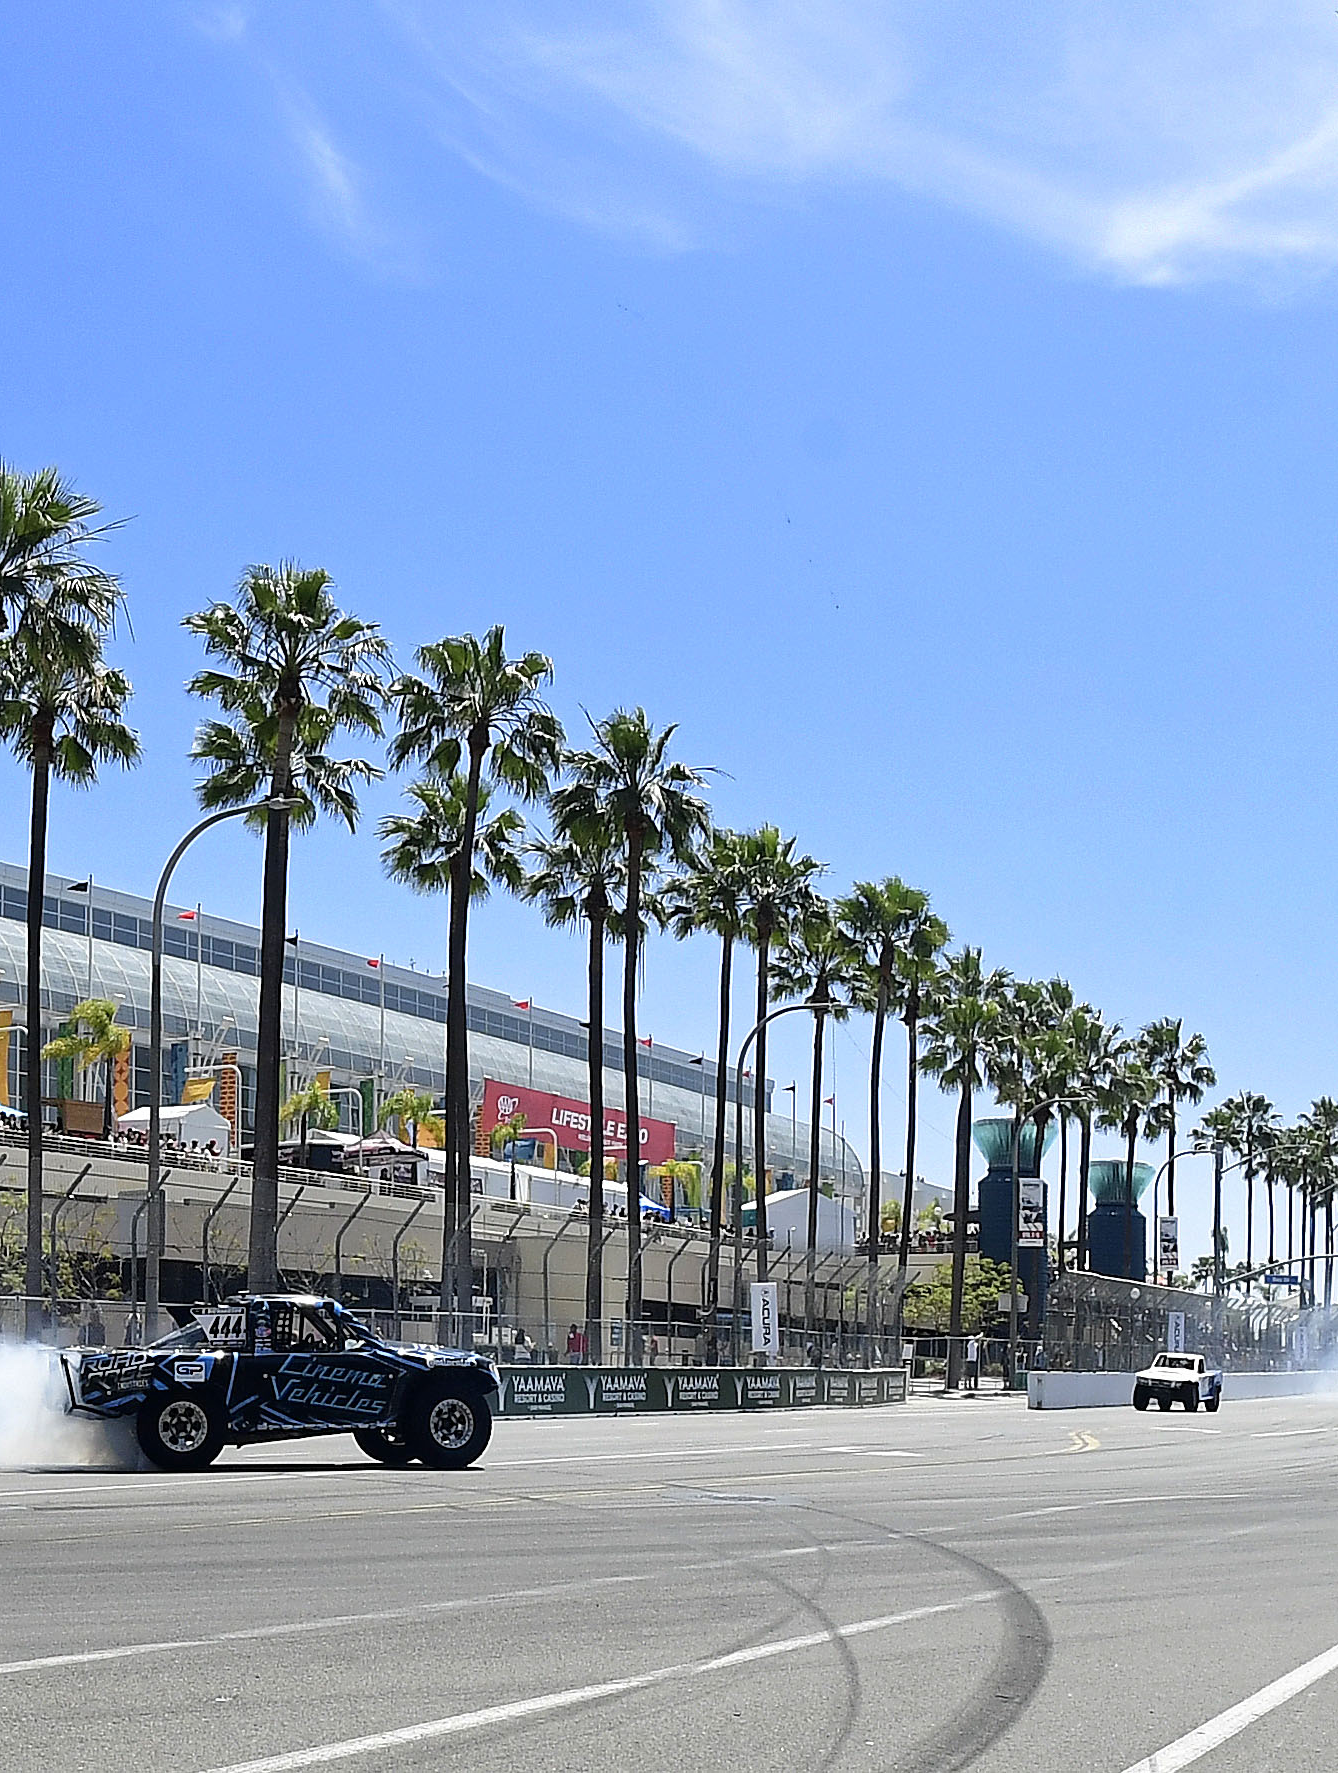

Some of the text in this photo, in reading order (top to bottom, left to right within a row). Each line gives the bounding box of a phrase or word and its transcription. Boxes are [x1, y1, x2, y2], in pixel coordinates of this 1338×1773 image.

[208, 1316, 243, 1338] 444
[762, 1298, 771, 1347] ACURA
[278, 1353, 386, 1388] Cinema
[271, 1376, 386, 1413] Vehicles
